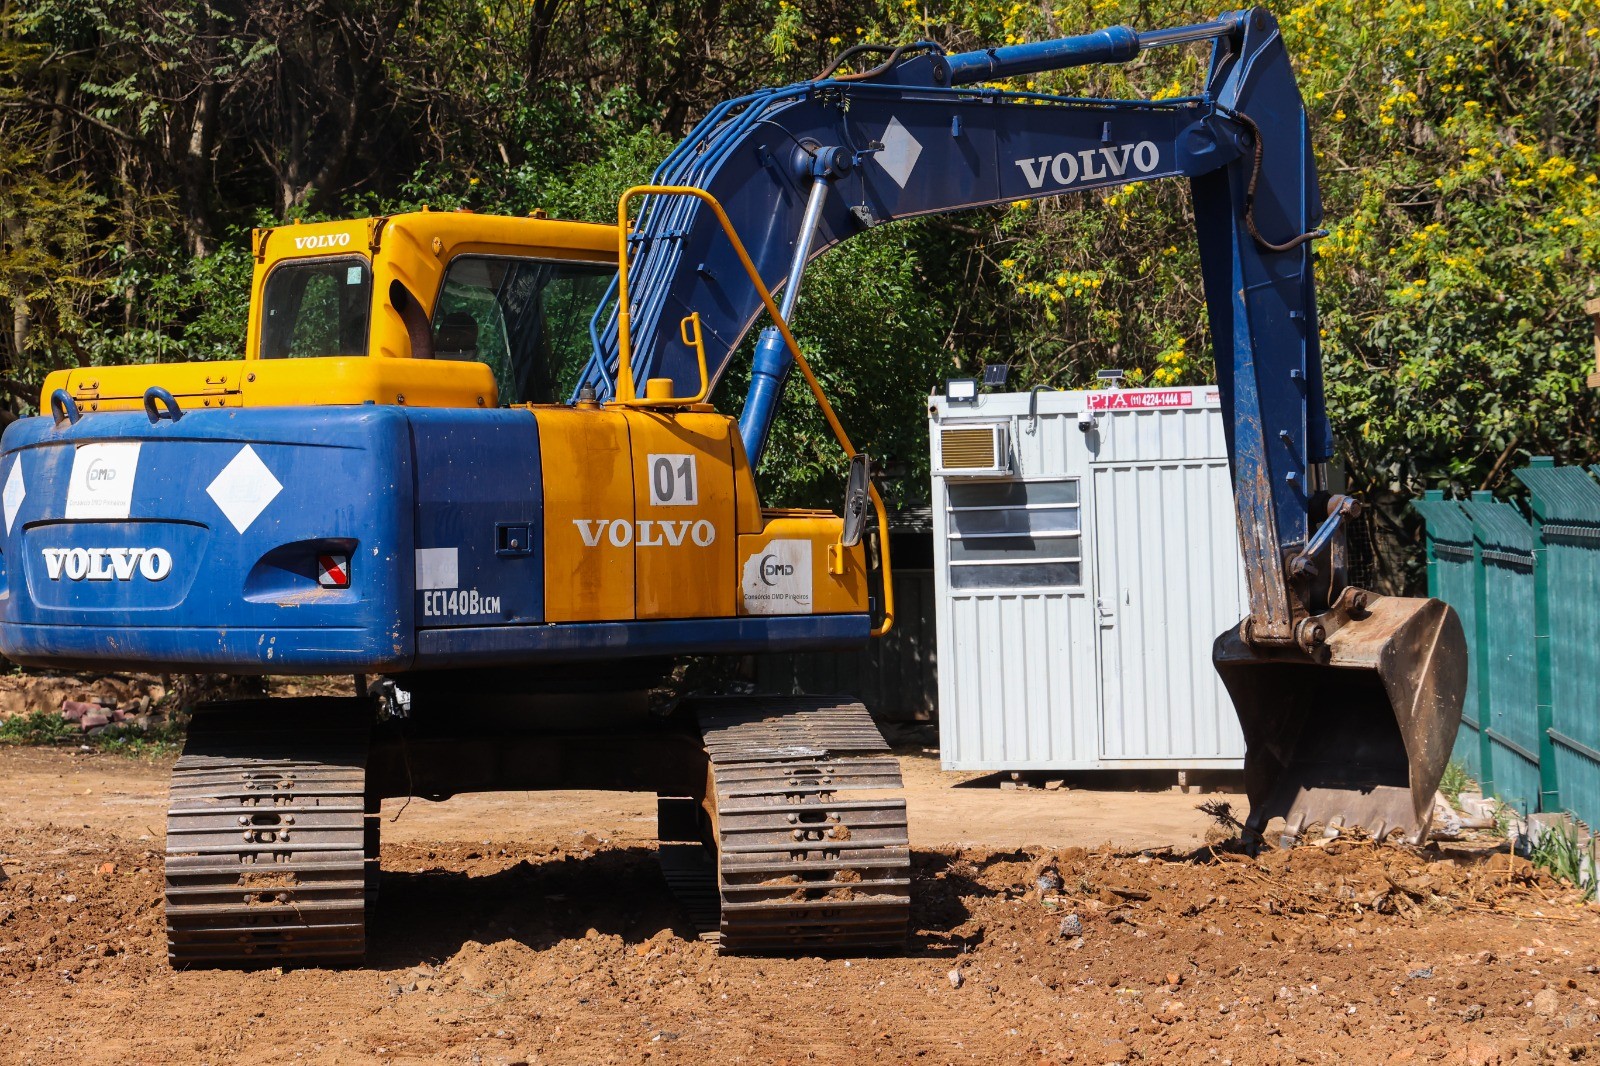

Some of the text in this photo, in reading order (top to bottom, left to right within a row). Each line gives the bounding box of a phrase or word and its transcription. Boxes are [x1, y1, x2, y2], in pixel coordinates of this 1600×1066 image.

[1015, 140, 1160, 189] VOLVO
[294, 232, 350, 250] VOLVO
[1088, 394, 1128, 406] PTA
[1142, 393, 1178, 406] 4224-1444
[653, 457, 694, 502] 01
[572, 519, 716, 547] VOLVO
[42, 547, 172, 582] VOLVO
